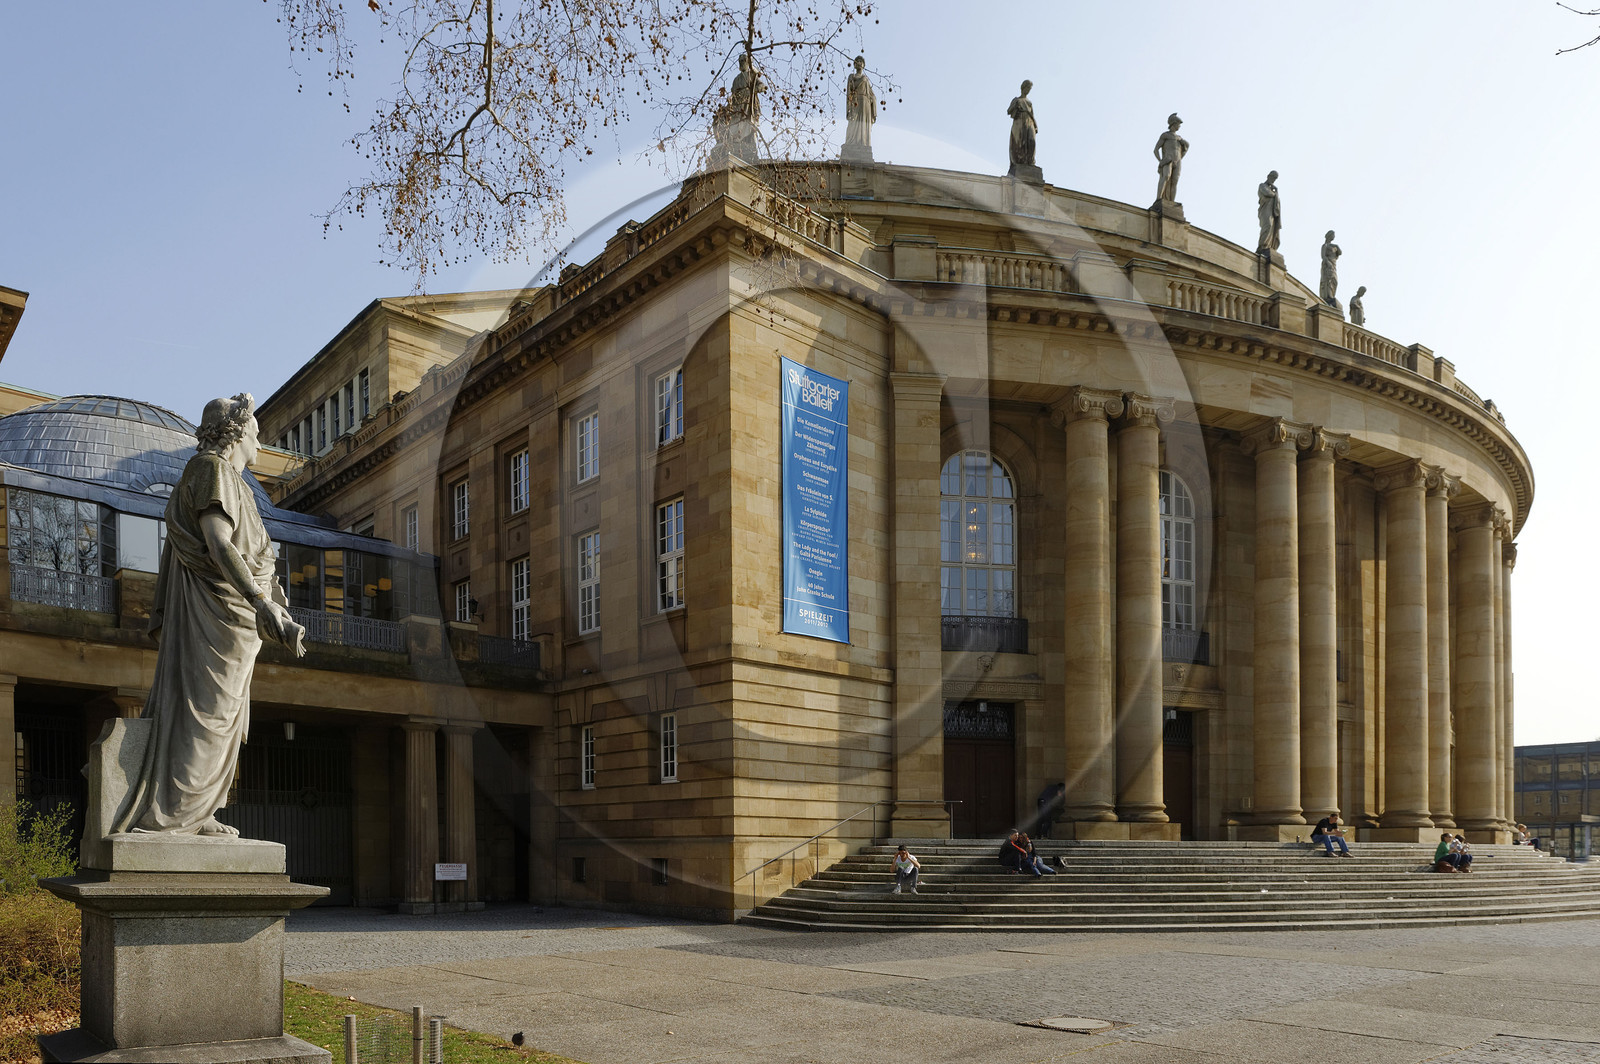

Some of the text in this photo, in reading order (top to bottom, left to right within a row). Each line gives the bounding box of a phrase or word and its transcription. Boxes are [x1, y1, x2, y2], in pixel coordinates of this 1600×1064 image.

[789, 368, 840, 401] Stuttgarter
[802, 388, 833, 412] Ballett
[794, 453, 812, 463] Orpheus
[821, 462, 837, 473] Eurydike
[803, 471, 829, 484] Schwanensee
[810, 508, 827, 518] Sylphide
[793, 541, 801, 549] The
[802, 544, 811, 553] Lady
[807, 588, 821, 597] Cranko
[821, 592, 835, 600] Schule
[799, 608, 834, 623] SPIELZEIT
[804, 618, 828, 628] 2011/2012
